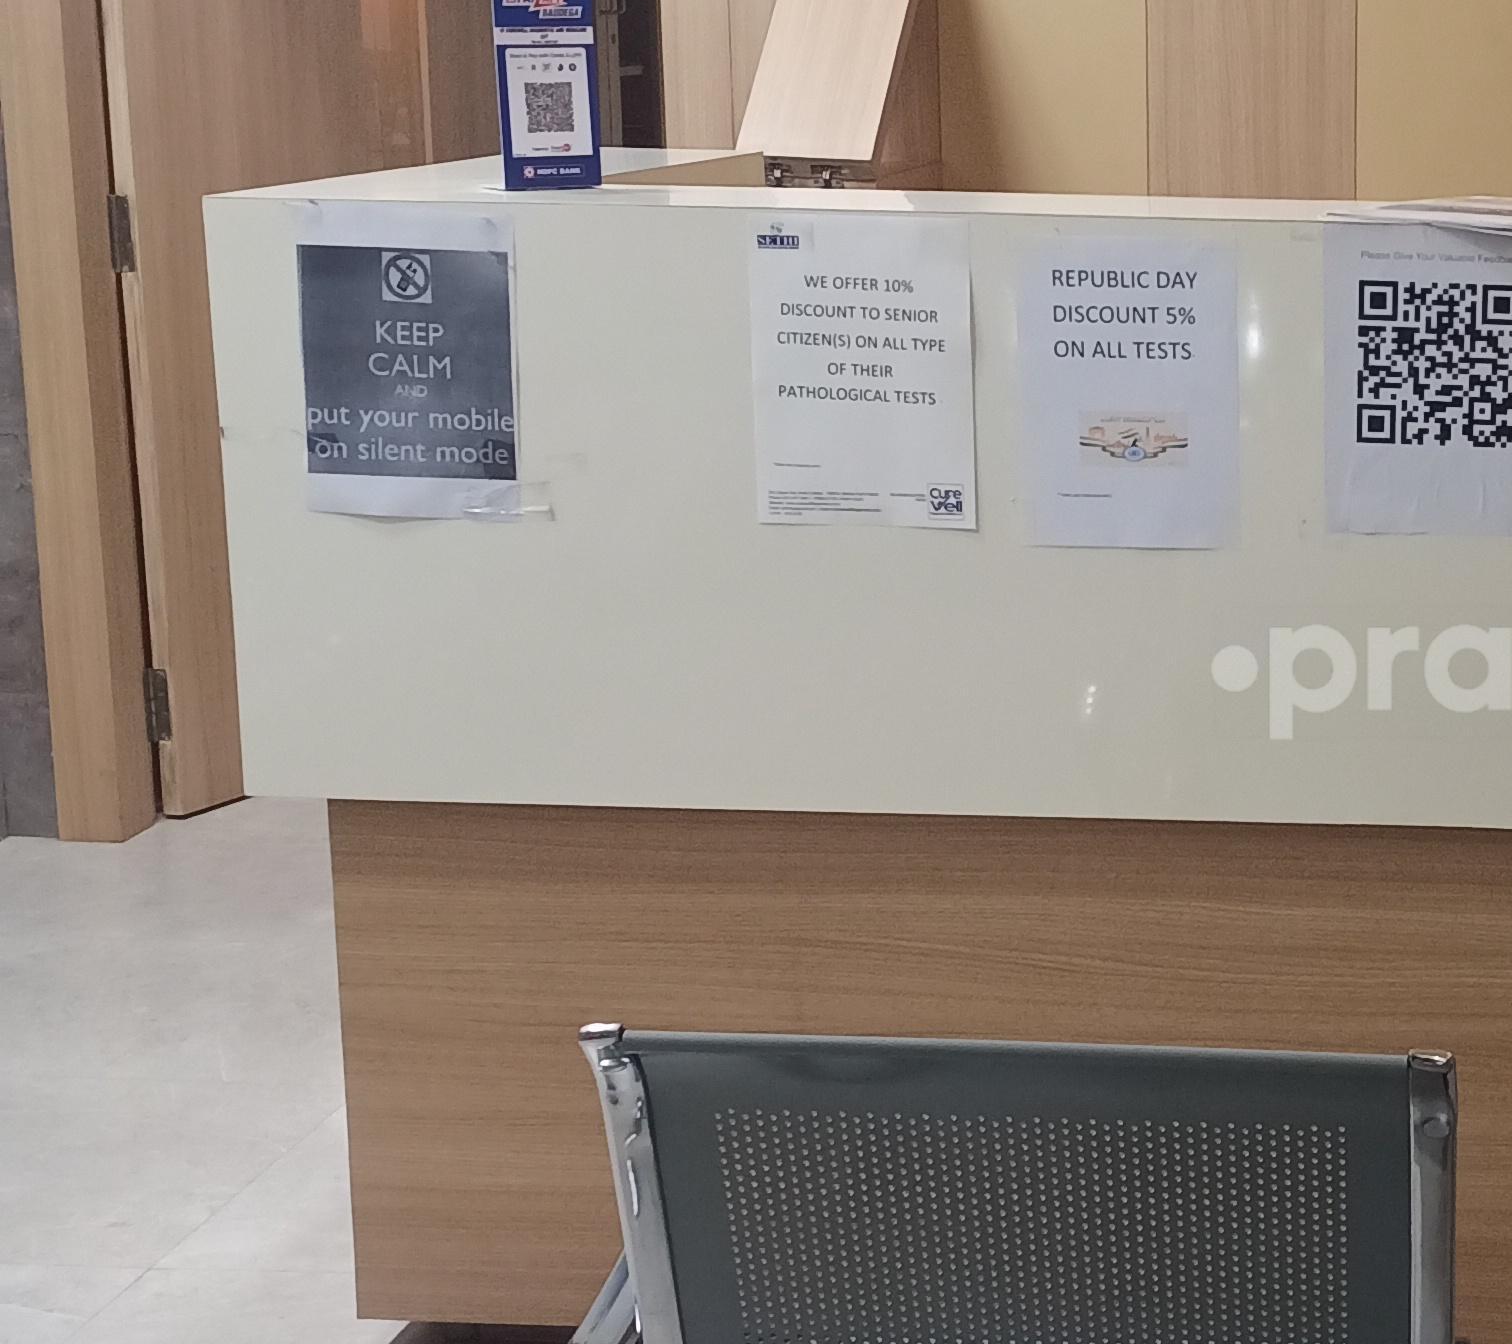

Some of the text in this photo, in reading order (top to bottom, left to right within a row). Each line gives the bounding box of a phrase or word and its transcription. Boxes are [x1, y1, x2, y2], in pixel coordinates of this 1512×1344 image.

[804, 275, 914, 293] WE OFFER 10%
[1052, 270, 1198, 289] REPUBLIC DAY
[780, 302, 938, 323] DISCOUNT TO SENIOR
[1053, 305, 1196, 325] DISCOUNT 5%
[375, 320, 444, 346] KEEP
[777, 331, 946, 352] CITIZEN(S) ON ALL TYPE
[1054, 340, 1085, 358] ON
[1092, 341, 1127, 358] ALL
[368, 353, 451, 379] CALM
[827, 362, 893, 378] OF THEIR
[394, 384, 428, 398] AND
[778, 385, 890, 402] PATHOLOGICAL
[307, 406, 514, 432] put your mobile
[315, 437, 509, 464] on silent mode
